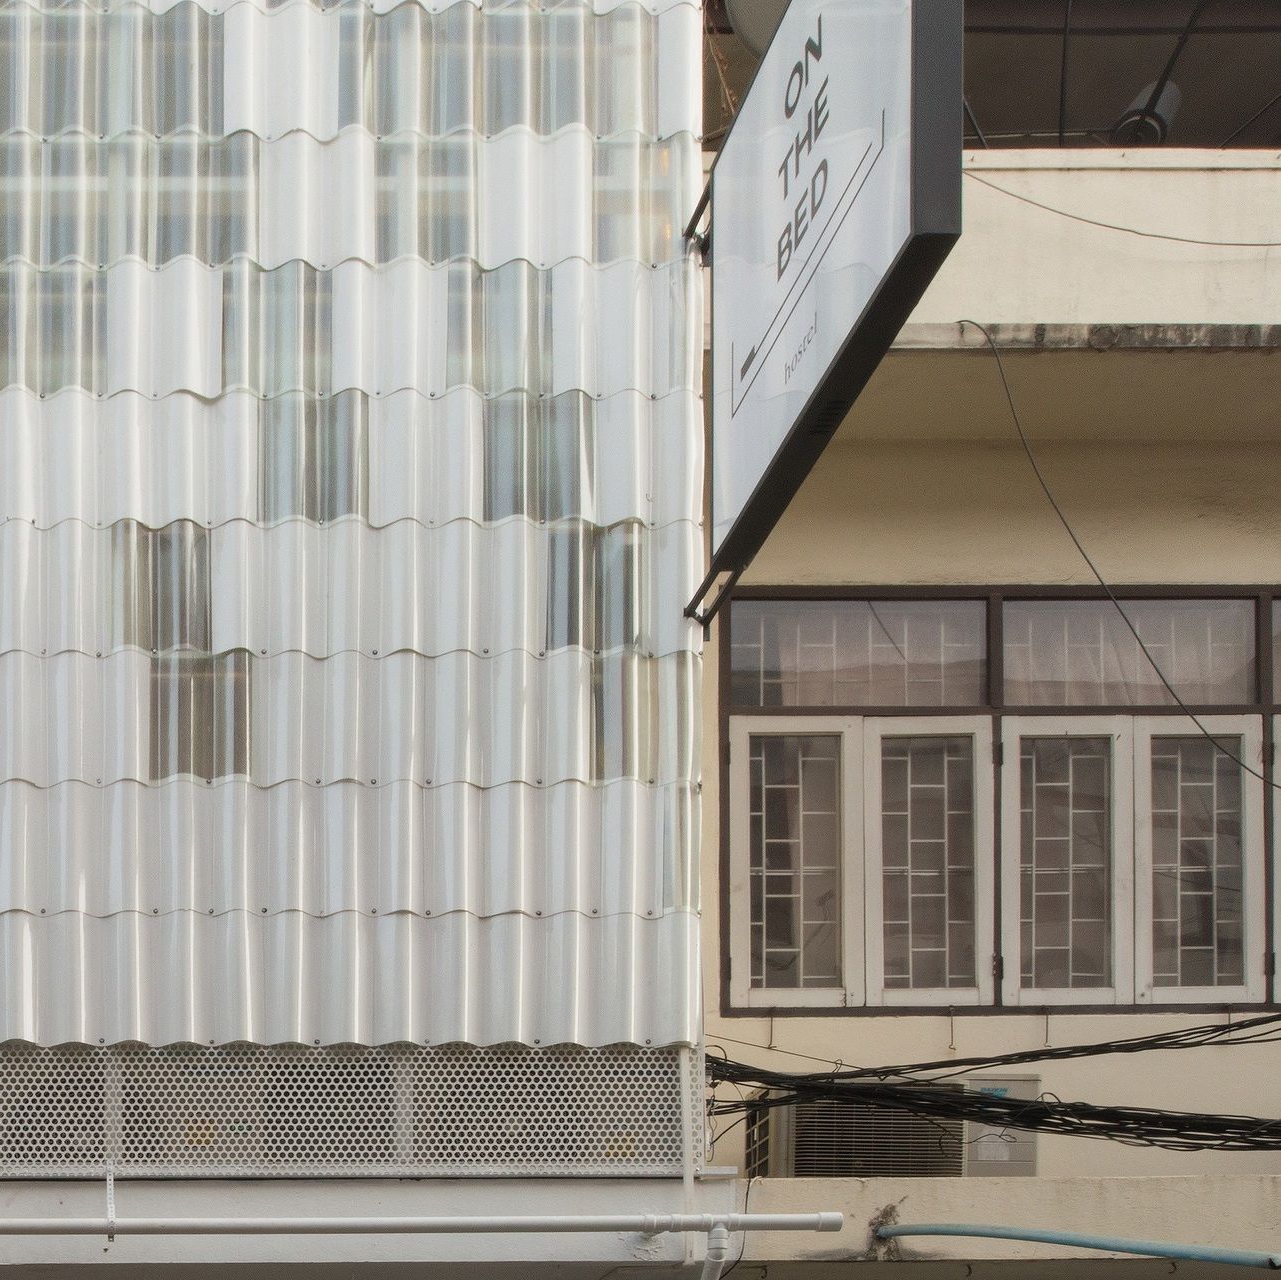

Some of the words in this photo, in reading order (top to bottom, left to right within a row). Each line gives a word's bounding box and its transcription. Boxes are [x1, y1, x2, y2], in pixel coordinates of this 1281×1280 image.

[784, 13, 822, 119] ON
[778, 75, 830, 201] THE
[777, 158, 828, 283] BED
[784, 311, 818, 385] hostel
